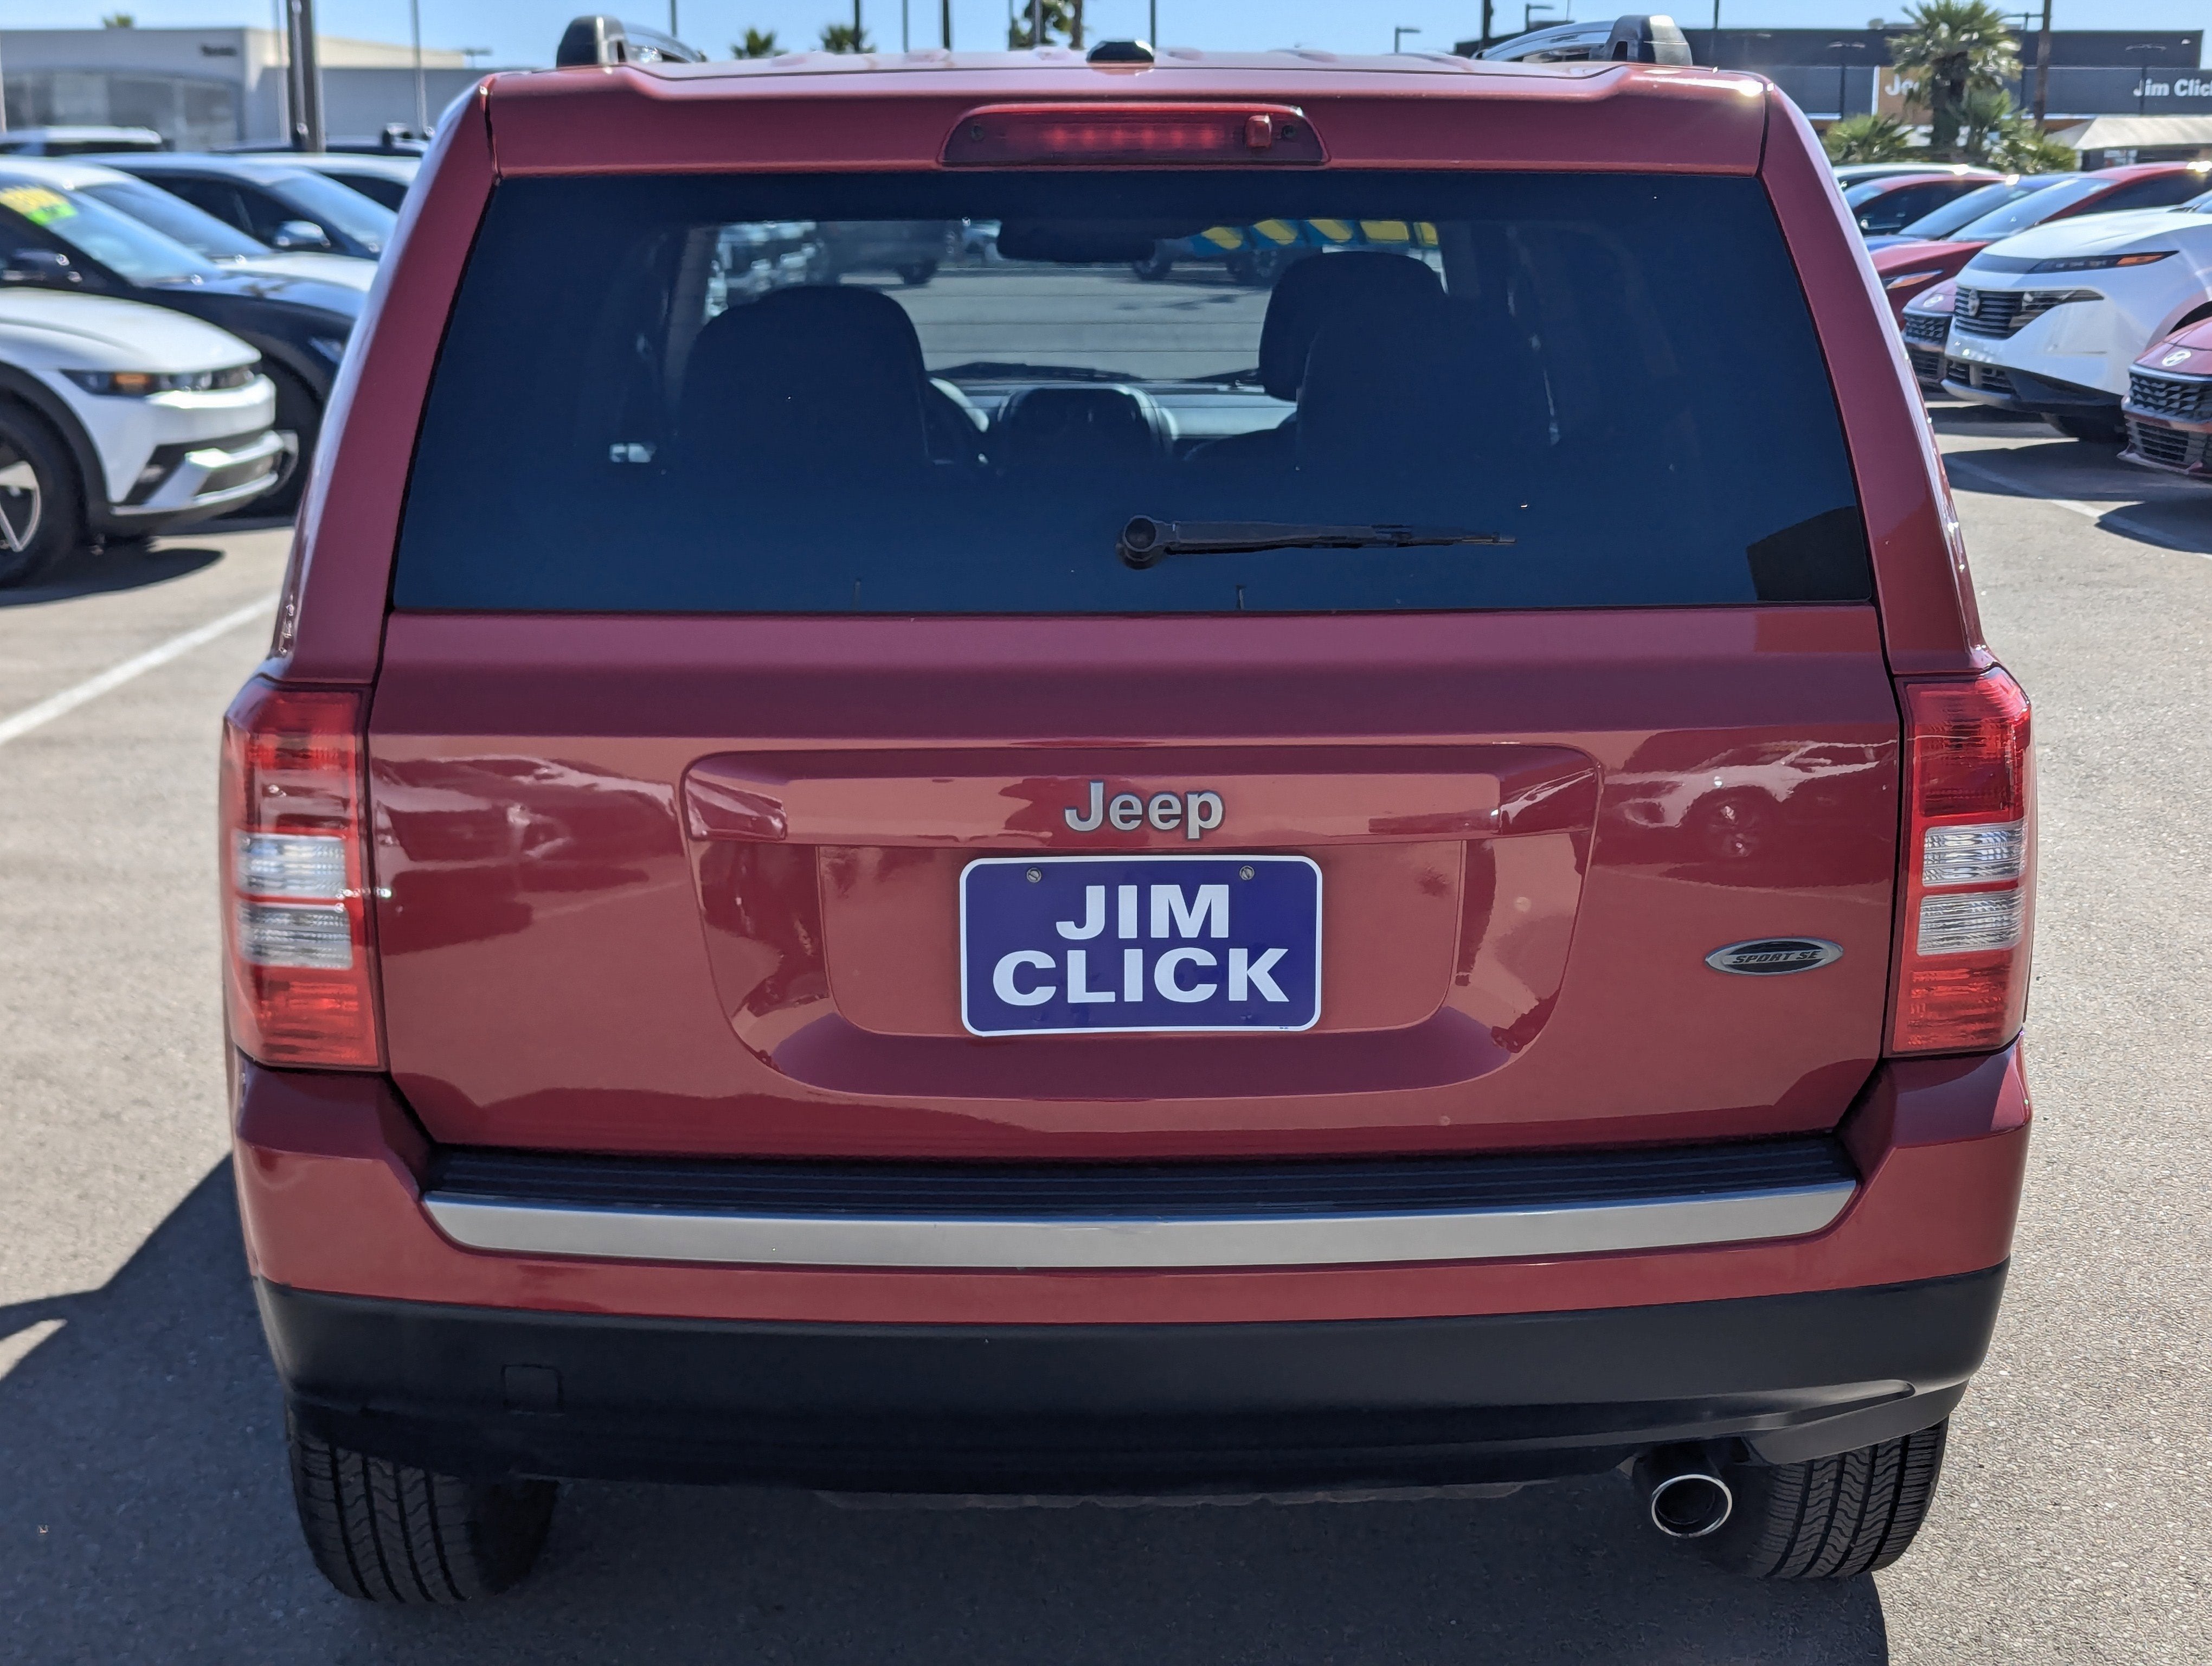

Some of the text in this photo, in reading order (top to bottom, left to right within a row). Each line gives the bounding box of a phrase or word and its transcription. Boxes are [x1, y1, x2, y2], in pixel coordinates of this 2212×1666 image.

[2133, 78, 2212, 97] Jim Clic
[1064, 781, 1224, 840] Jeep
[1056, 884, 1229, 940] JIM
[993, 947, 1290, 1005] CLICK
[1732, 951, 1821, 964] SPORT SE
